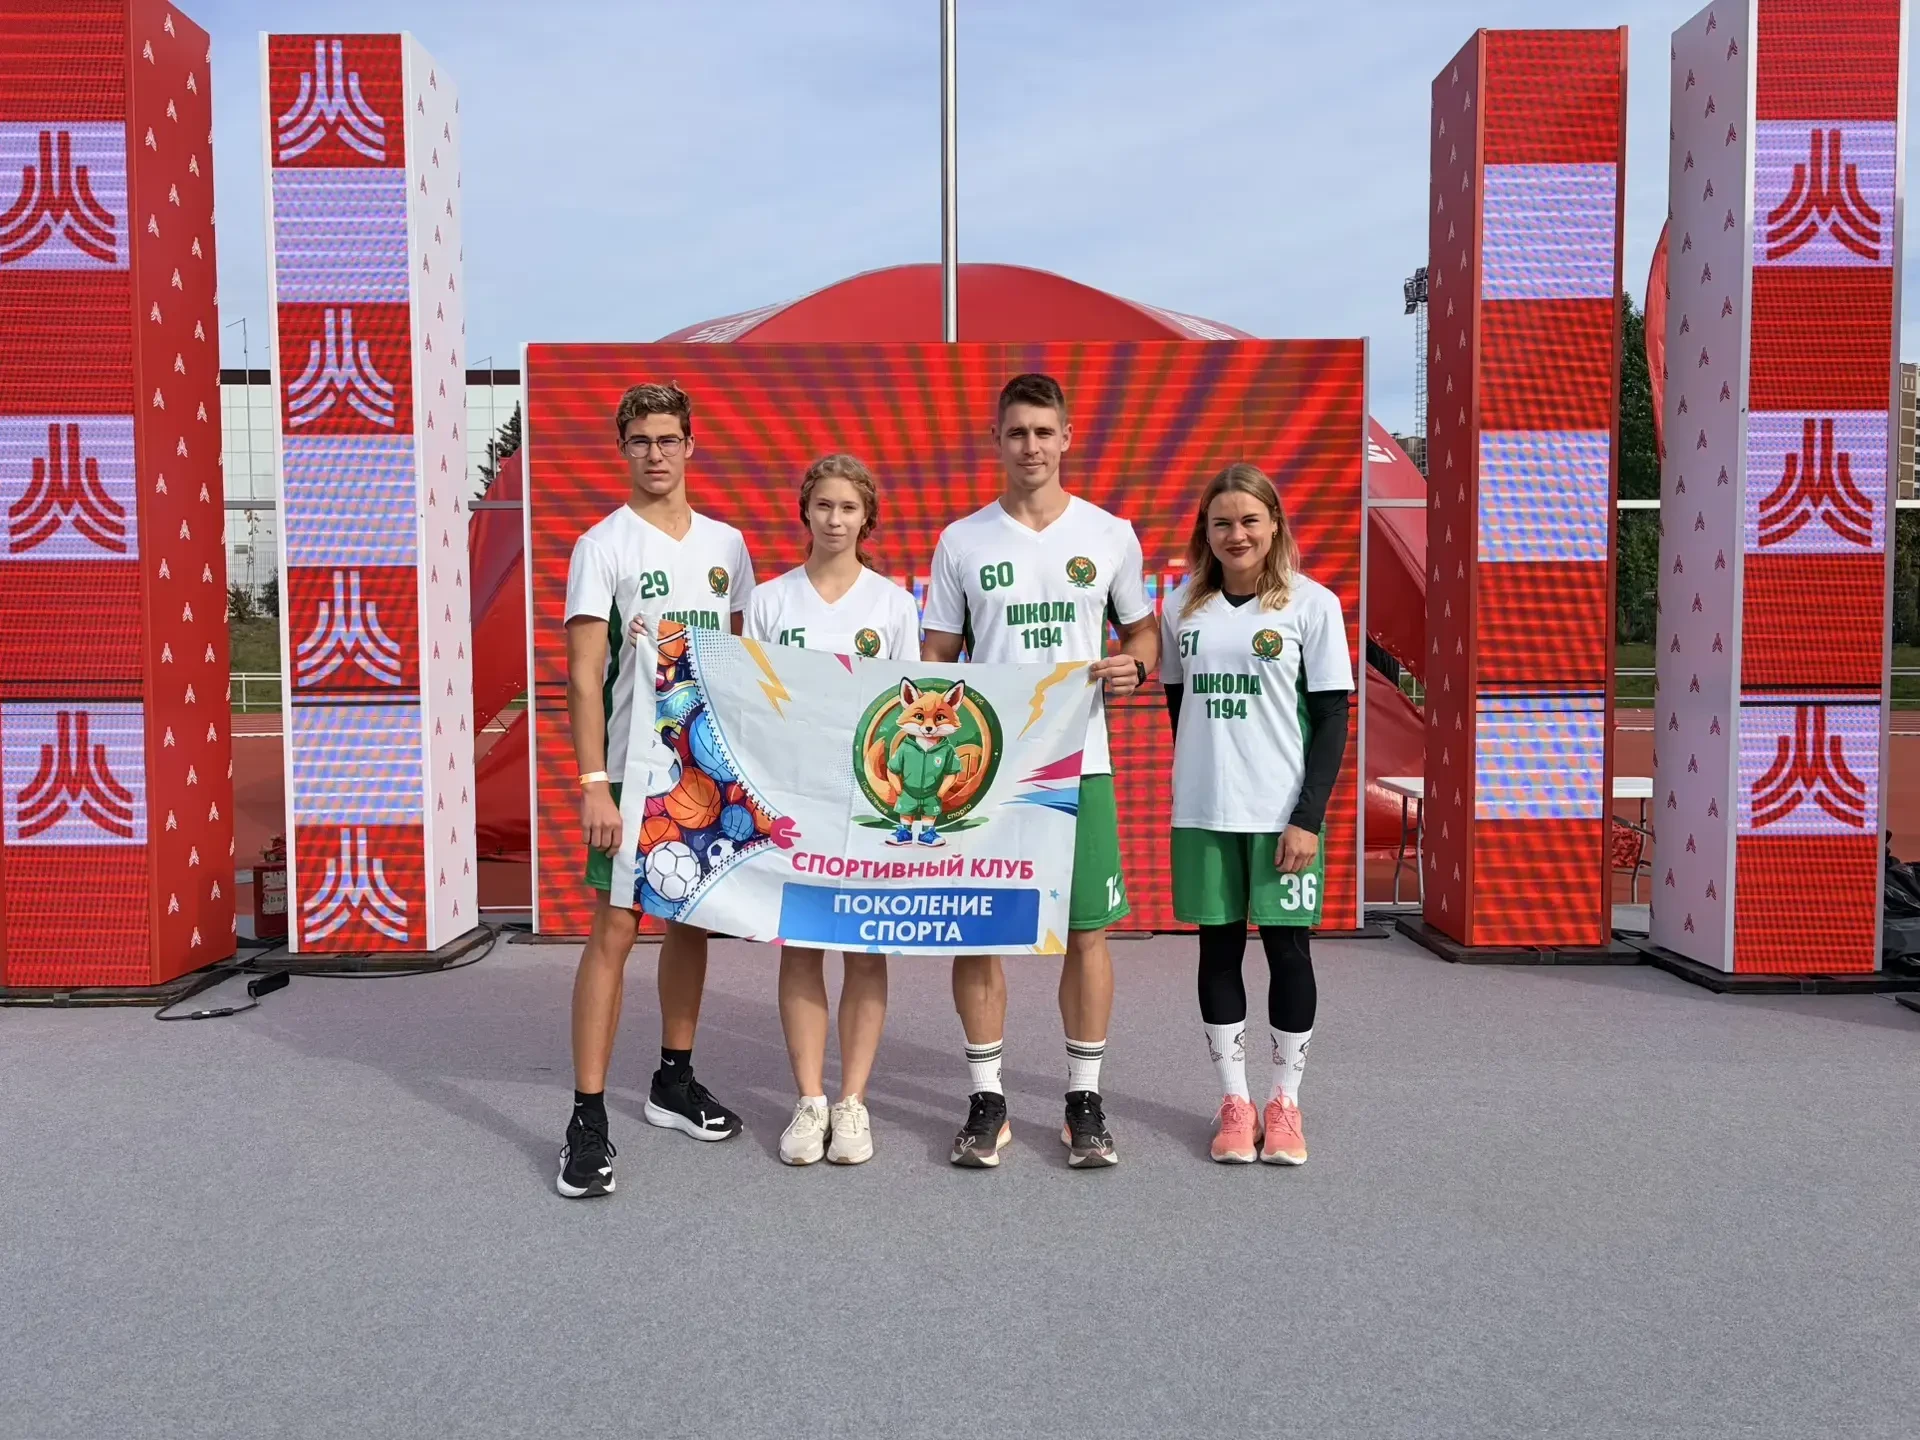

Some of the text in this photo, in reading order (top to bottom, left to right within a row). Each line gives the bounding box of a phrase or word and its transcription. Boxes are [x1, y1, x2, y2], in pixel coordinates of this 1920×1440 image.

[640, 570, 669, 600] 29
[979, 561, 1015, 591] 60
[1006, 601, 1076, 626] ШКОЛА
[1021, 626, 1063, 649] 1194
[1179, 629, 1200, 658] 51
[1192, 672, 1262, 695] ШКОЛА
[1205, 698, 1248, 719] 1194
[791, 852, 1034, 879] СПОРТИВНЫЙ КЛУБ
[1279, 873, 1318, 911] 36
[833, 894, 993, 916] ПОКОЛЕНИЕ
[859, 920, 963, 942] СПОРТА
